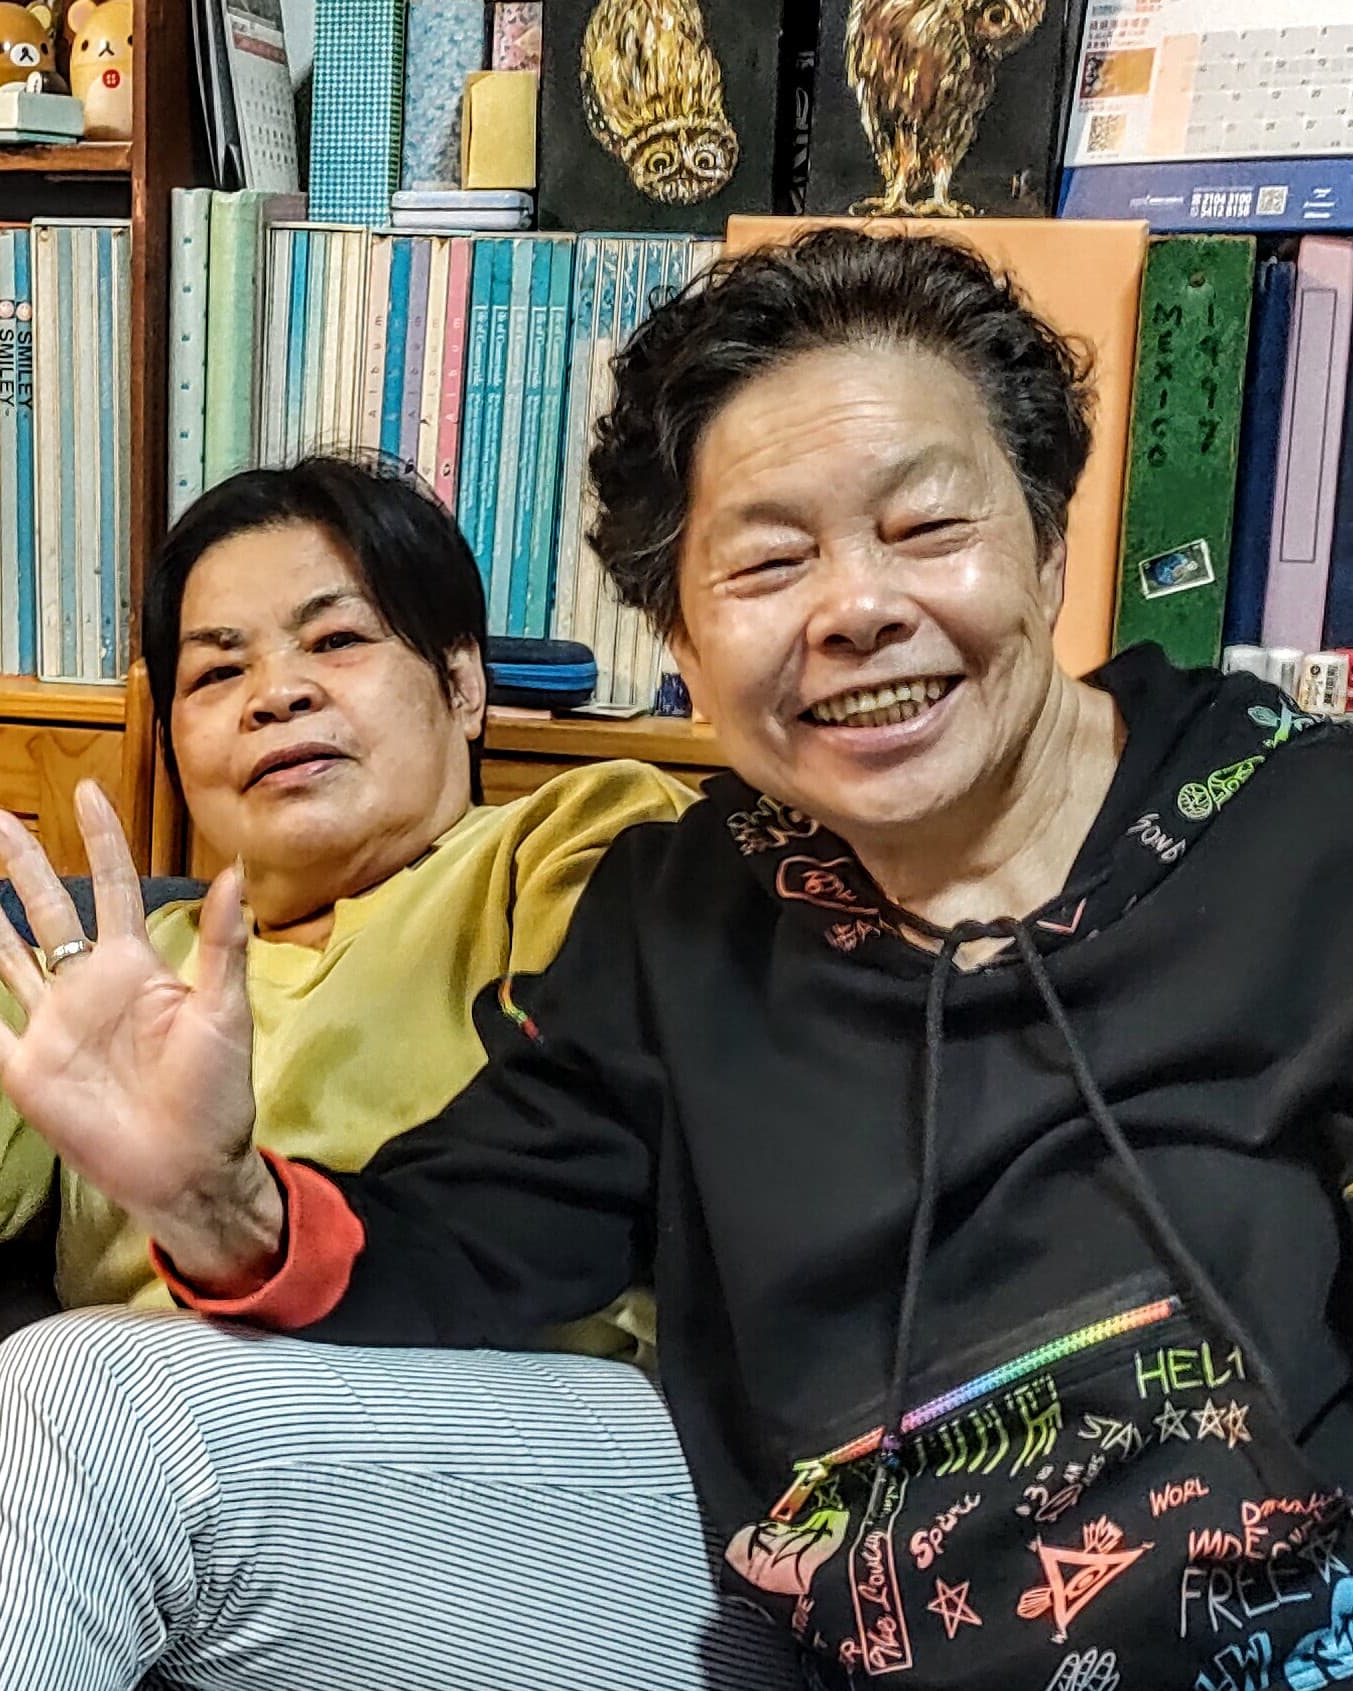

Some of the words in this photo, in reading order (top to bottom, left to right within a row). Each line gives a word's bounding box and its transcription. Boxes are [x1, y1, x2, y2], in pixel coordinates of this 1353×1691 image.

[0, 327, 15, 408] SMILEY
[17, 330, 33, 410] SMILEY
[1147, 301, 1183, 468] MEXICO
